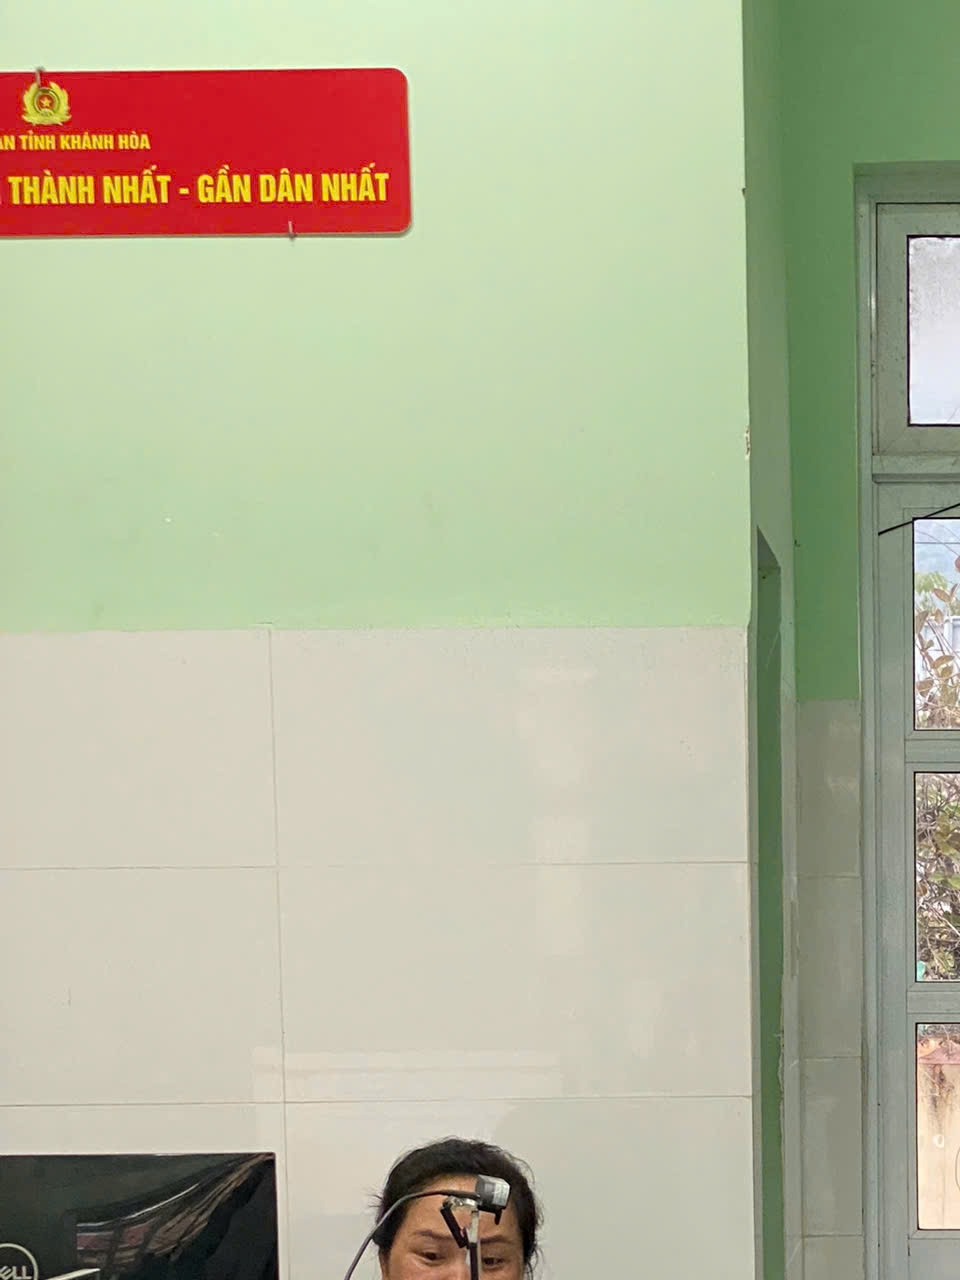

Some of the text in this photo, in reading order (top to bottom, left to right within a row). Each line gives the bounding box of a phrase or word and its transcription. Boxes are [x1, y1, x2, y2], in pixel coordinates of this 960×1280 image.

[18, 130, 56, 150] TỈNH
[60, 131, 114, 150] KHÁNH
[118, 130, 151, 150] HÒA
[8, 169, 95, 204] THÀNH
[103, 165, 171, 204] NHẤT
[197, 164, 251, 203] GẦN
[260, 168, 313, 202] DÂN
[321, 162, 389, 202] NHẤT
[0, 1265, 33, 1280] ELL
